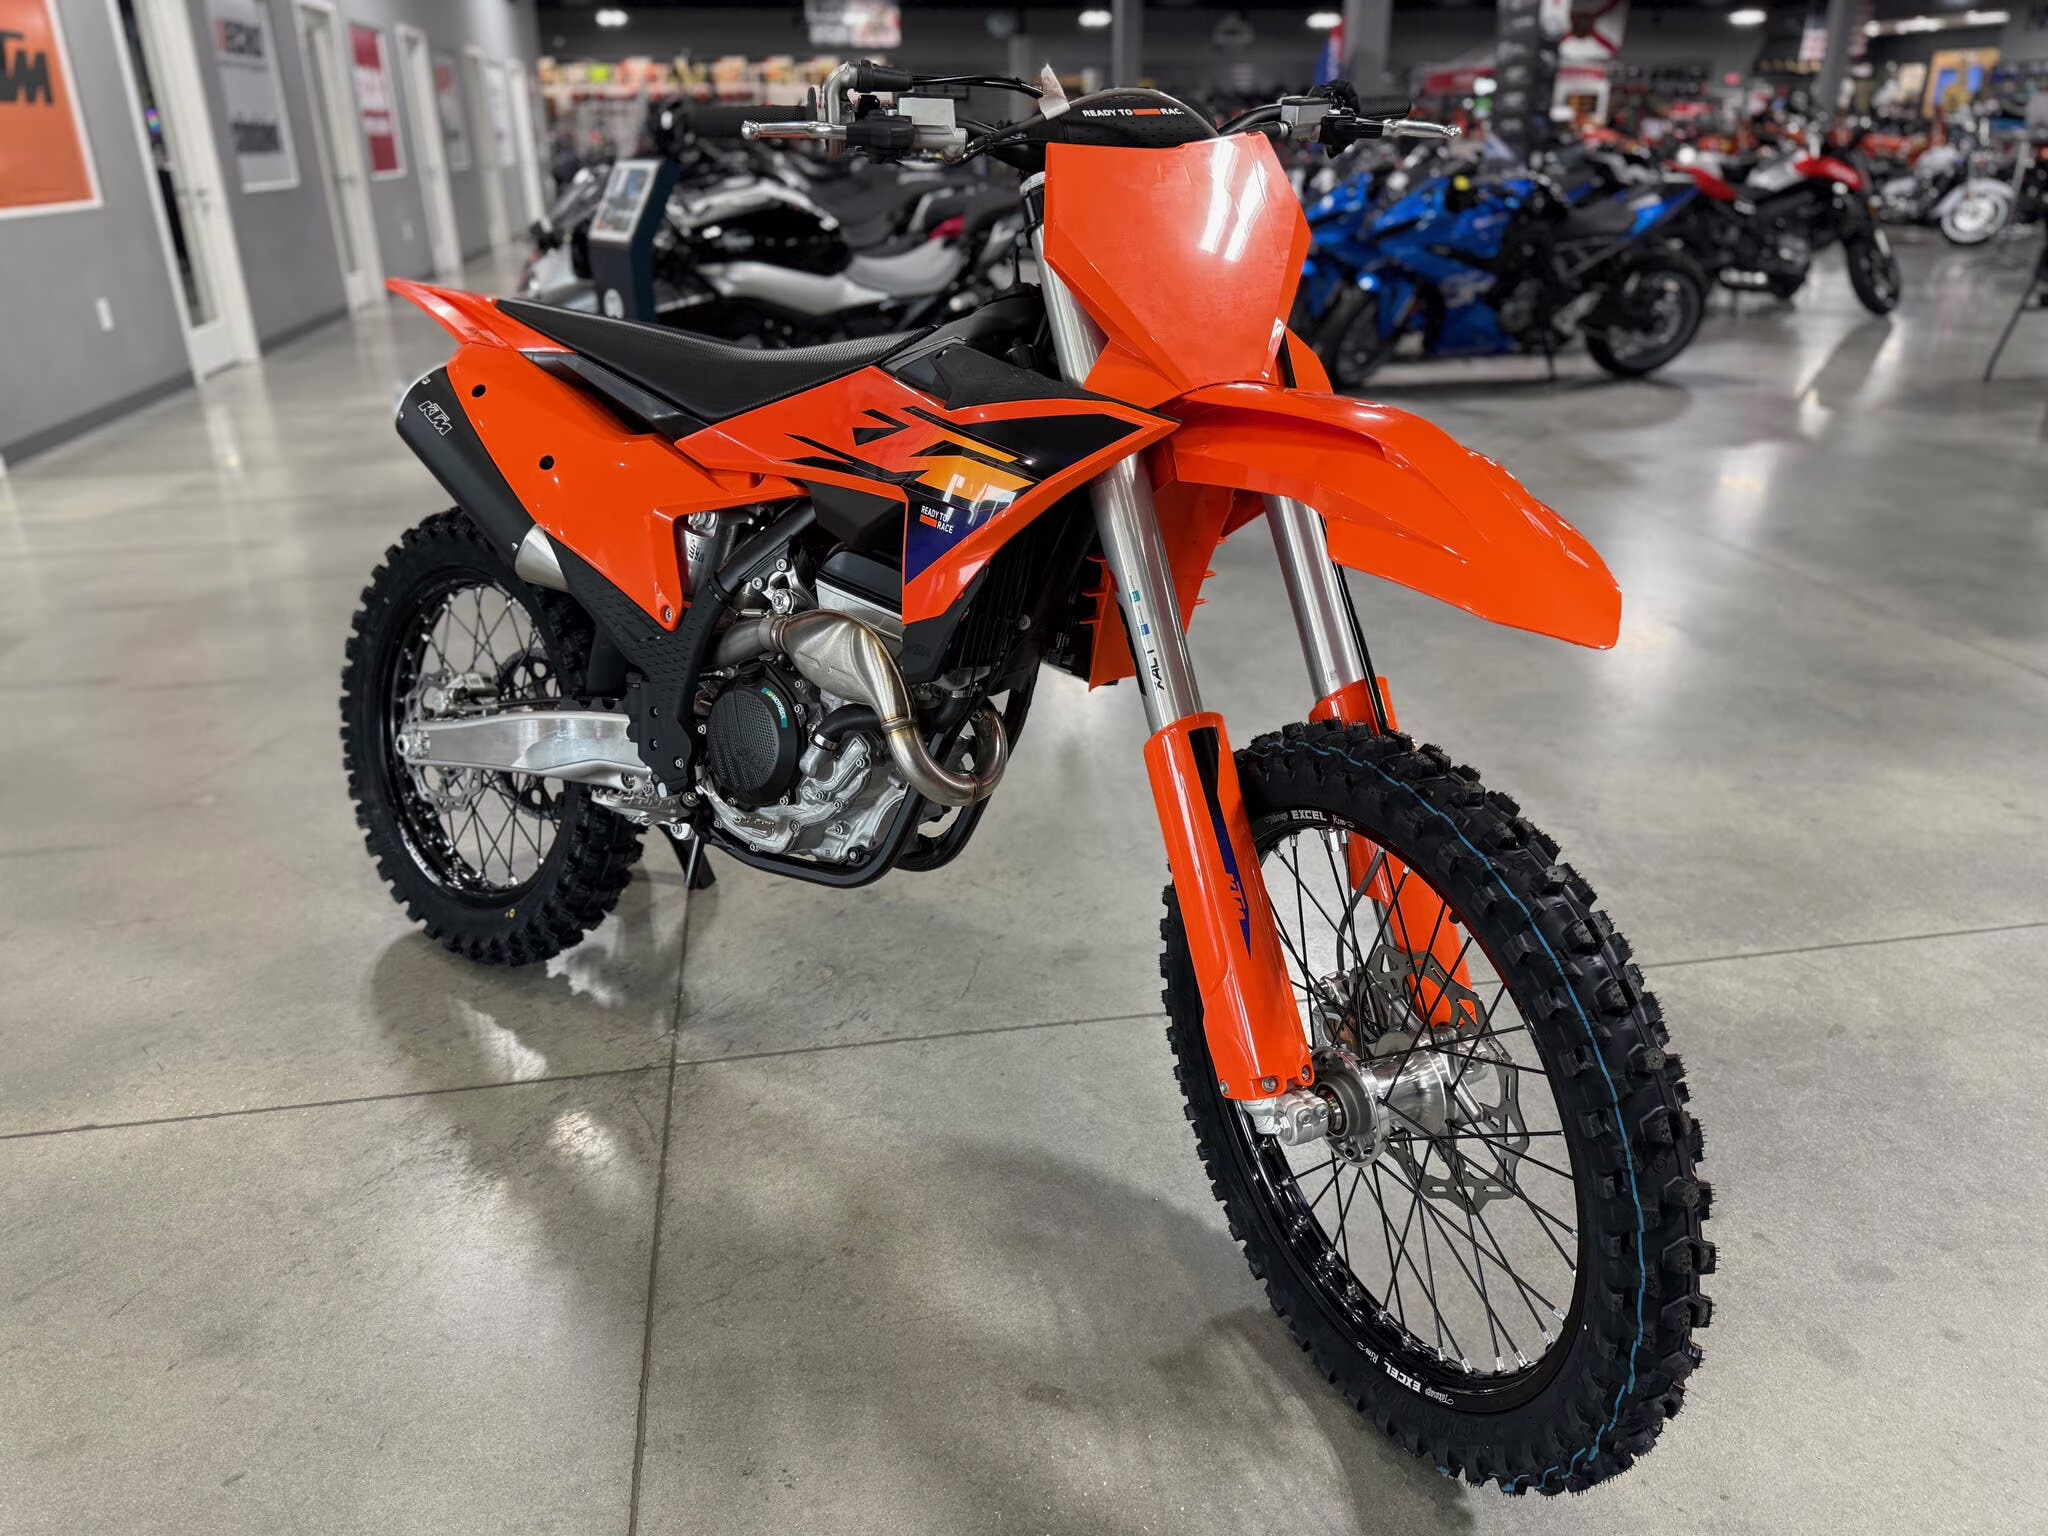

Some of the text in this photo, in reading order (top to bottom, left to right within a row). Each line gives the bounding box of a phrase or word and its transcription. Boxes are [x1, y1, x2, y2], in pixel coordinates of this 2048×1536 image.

[0, 31, 54, 106] TM
[1082, 108, 1185, 118] READY TO RAC
[418, 400, 453, 436] KTM
[921, 505, 950, 522] READY TO
[937, 521, 954, 534] RACE
[1290, 810, 1328, 821] EXCEL
[1383, 1361, 1421, 1393] EXCEL
